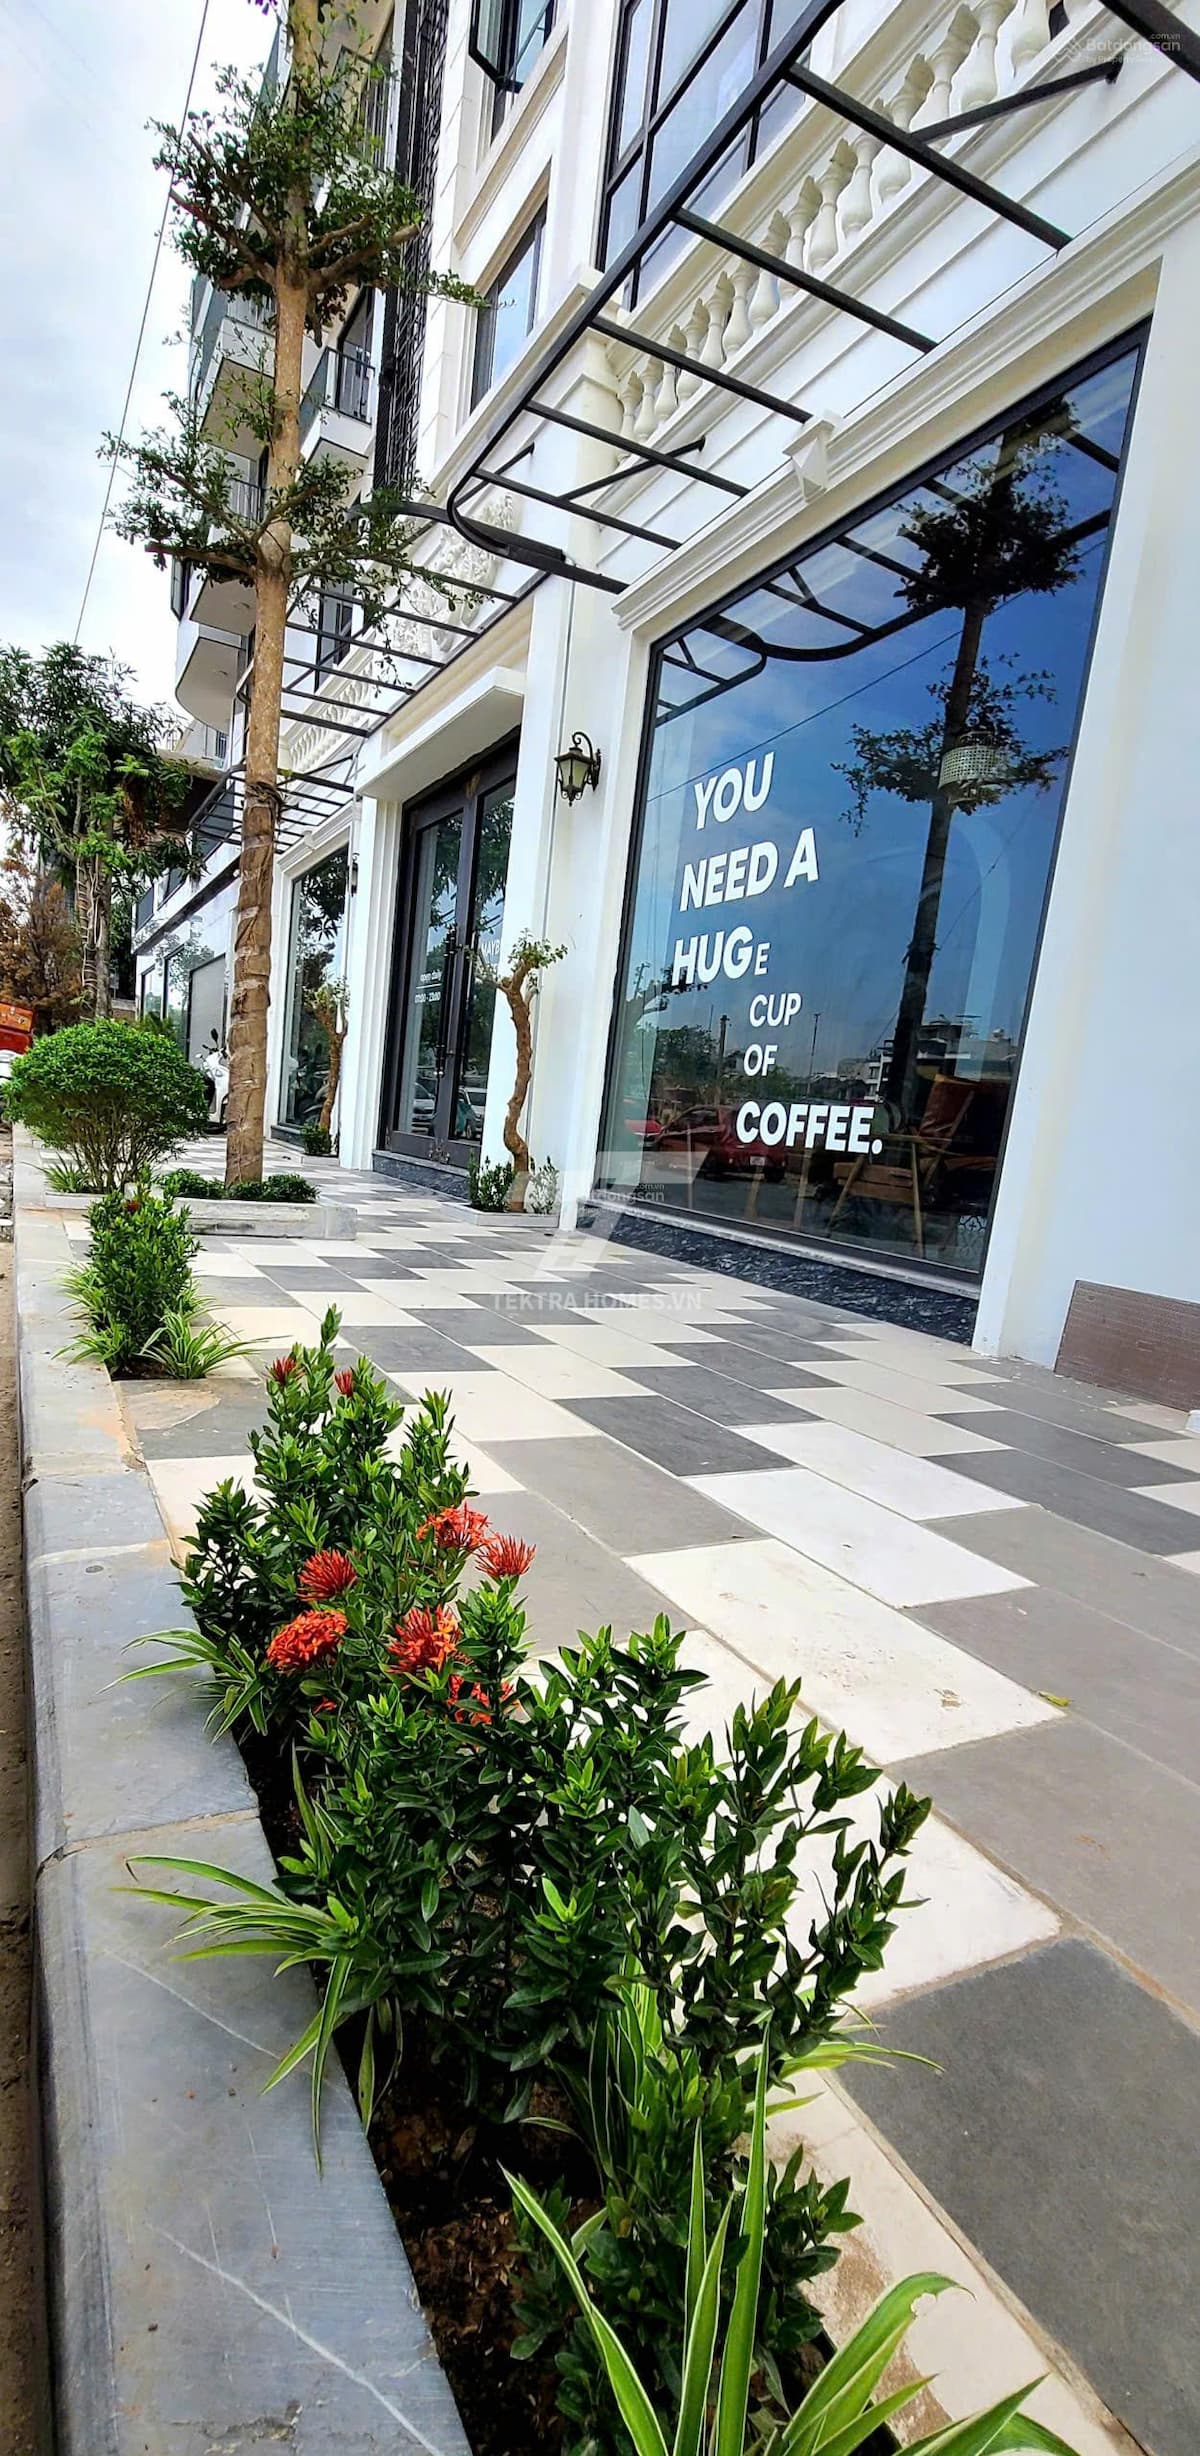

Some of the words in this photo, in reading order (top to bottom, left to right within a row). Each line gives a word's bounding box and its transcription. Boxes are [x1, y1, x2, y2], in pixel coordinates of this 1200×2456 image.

[694, 751, 776, 830] YOU
[679, 840, 779, 912] NEED
[784, 827, 820, 888] A
[749, 992, 802, 1028] CUP
[743, 1044, 778, 1077] OF
[735, 1101, 883, 1155] COFFEE.
